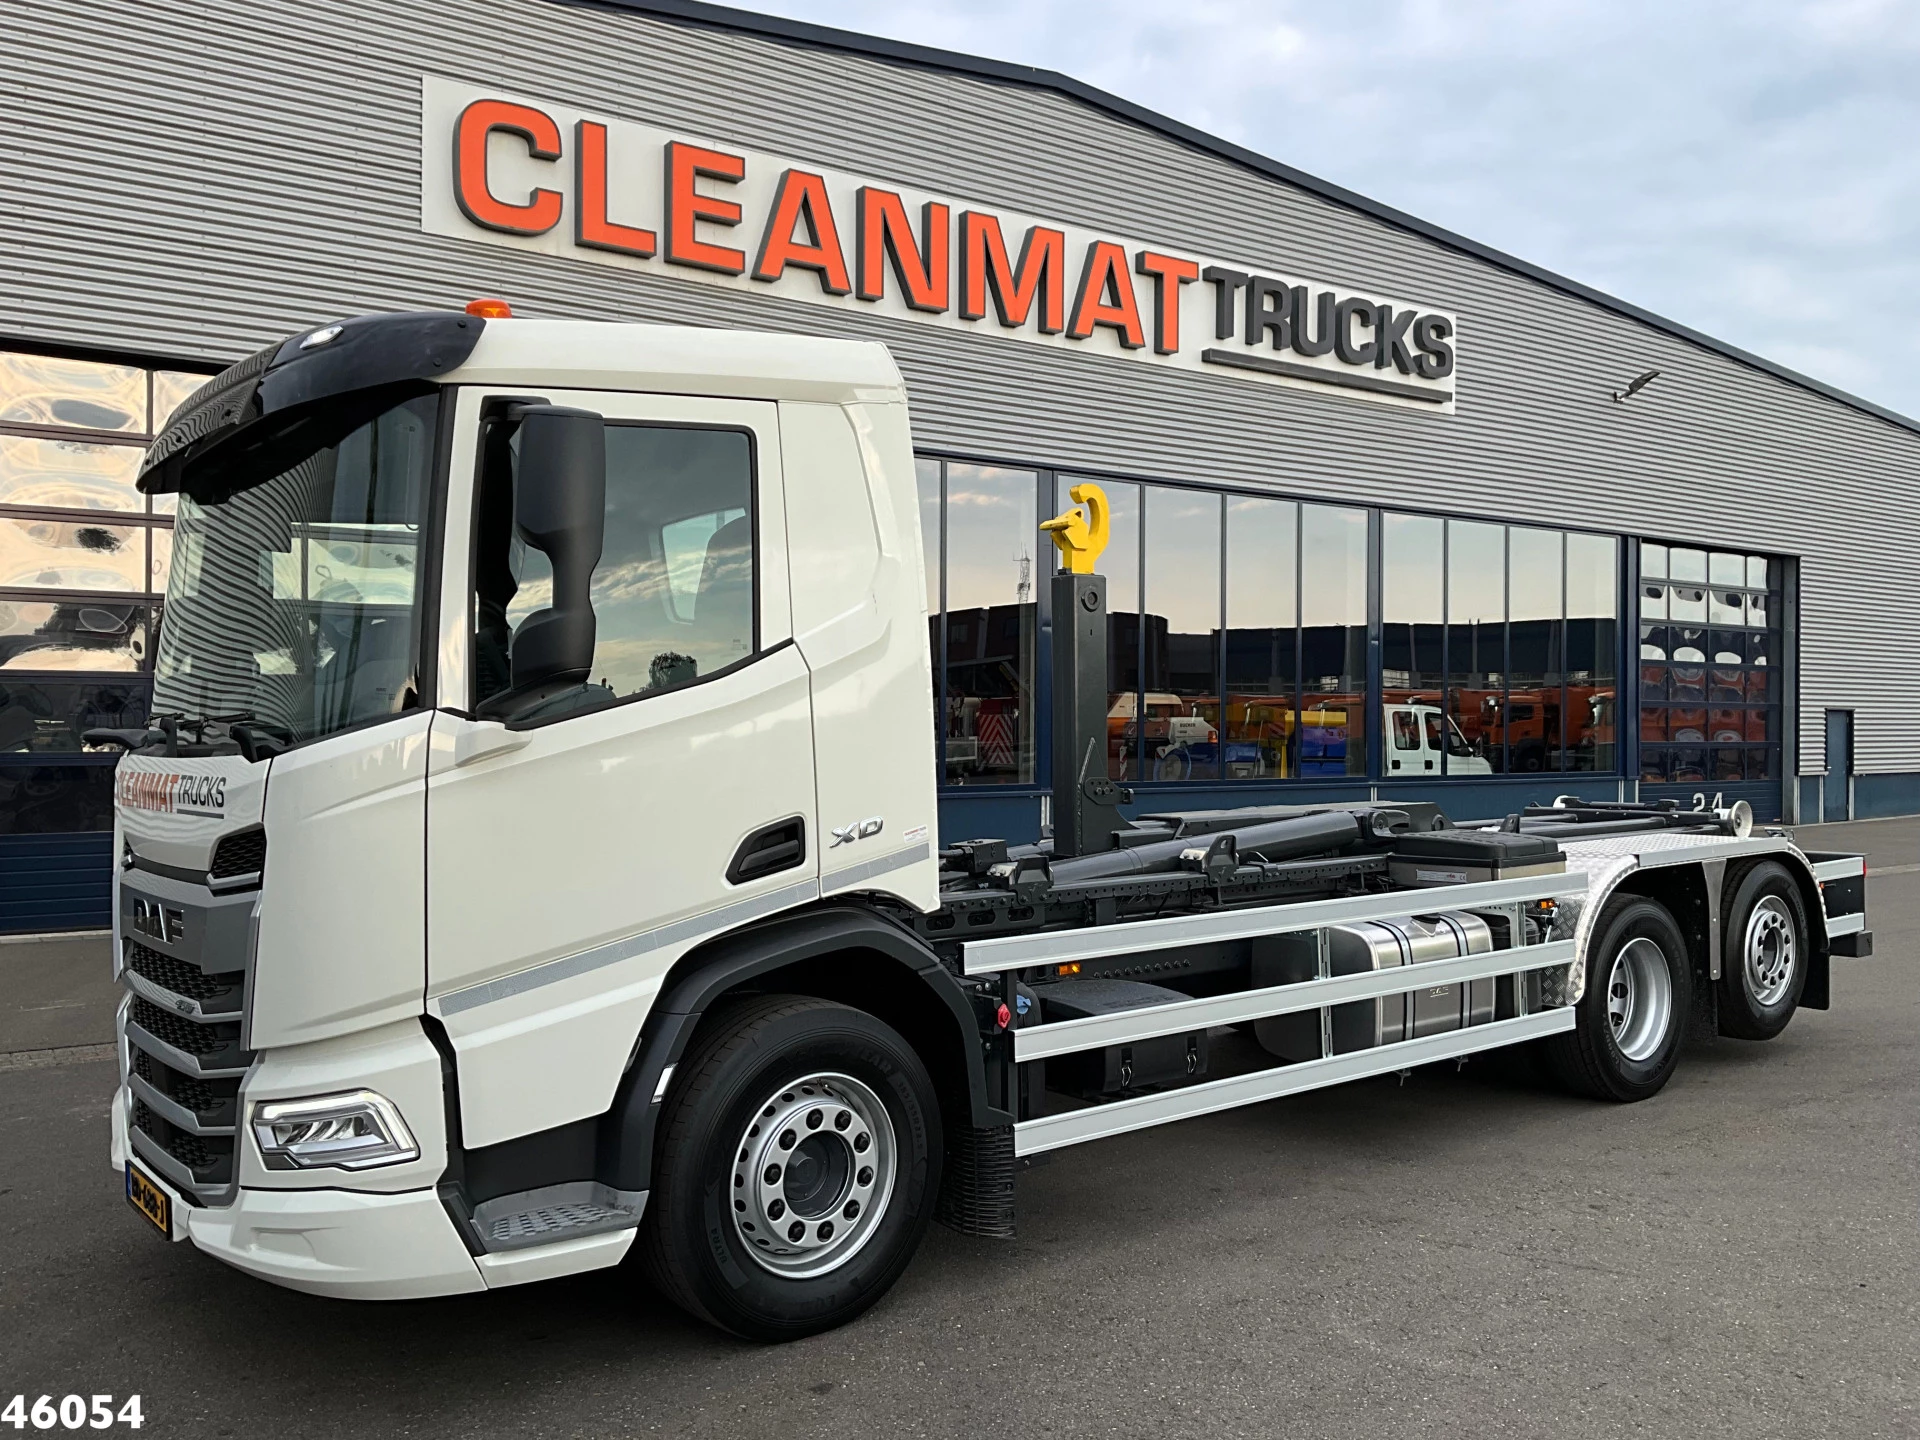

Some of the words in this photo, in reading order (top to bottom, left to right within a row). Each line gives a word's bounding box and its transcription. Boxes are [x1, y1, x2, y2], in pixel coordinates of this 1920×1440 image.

[452, 98, 1199, 355] CLEANMAT
[1202, 265, 1455, 379] TRUCKS
[178, 774, 227, 808] TRUCKS
[829, 815, 884, 849] XD
[133, 897, 185, 945] DAF
